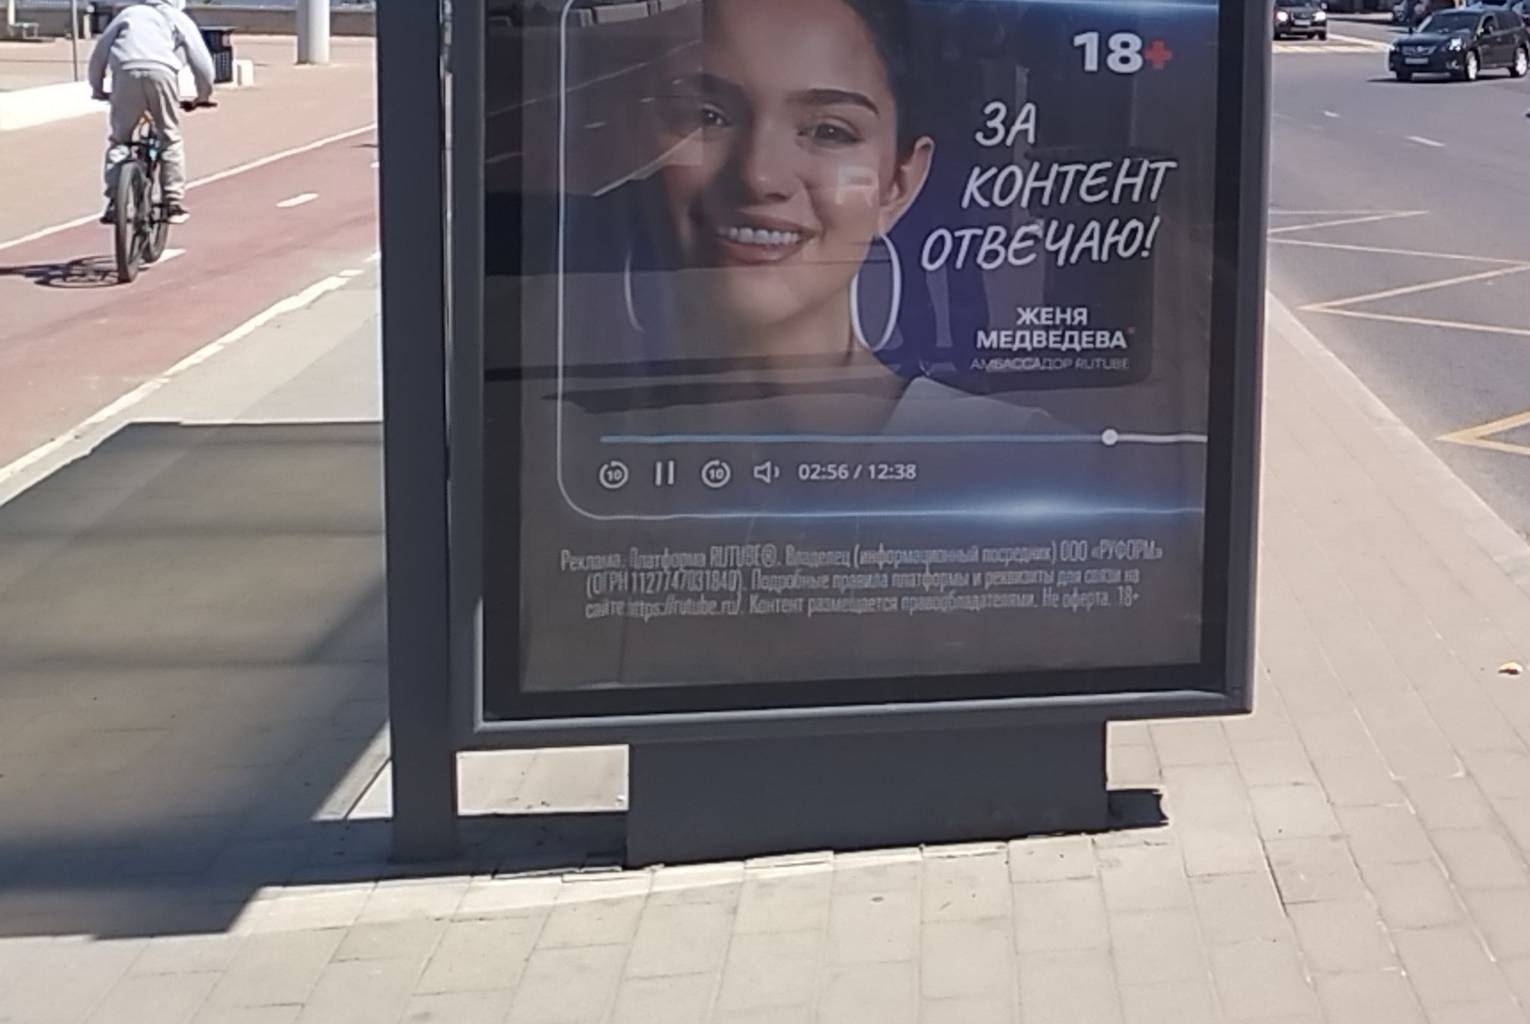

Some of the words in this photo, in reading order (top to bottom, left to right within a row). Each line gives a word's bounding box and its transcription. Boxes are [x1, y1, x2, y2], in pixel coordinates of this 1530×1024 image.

[1072, 31, 1173, 74] 18+
[975, 100, 1037, 147] ЗА
[961, 157, 1178, 209] КОНТЕНТ
[920, 215, 1161, 271] ОТВЕЧАЮ!
[1016, 307, 1088, 326] ЖЕНЯ
[976, 330, 1128, 352] МЕДВЕДЕВА
[970, 356, 1073, 372] АМБАССАДОР
[1075, 356, 1130, 371] RUTUBE
[798, 463, 849, 480] 02:56
[867, 463, 917, 480] 12:38
